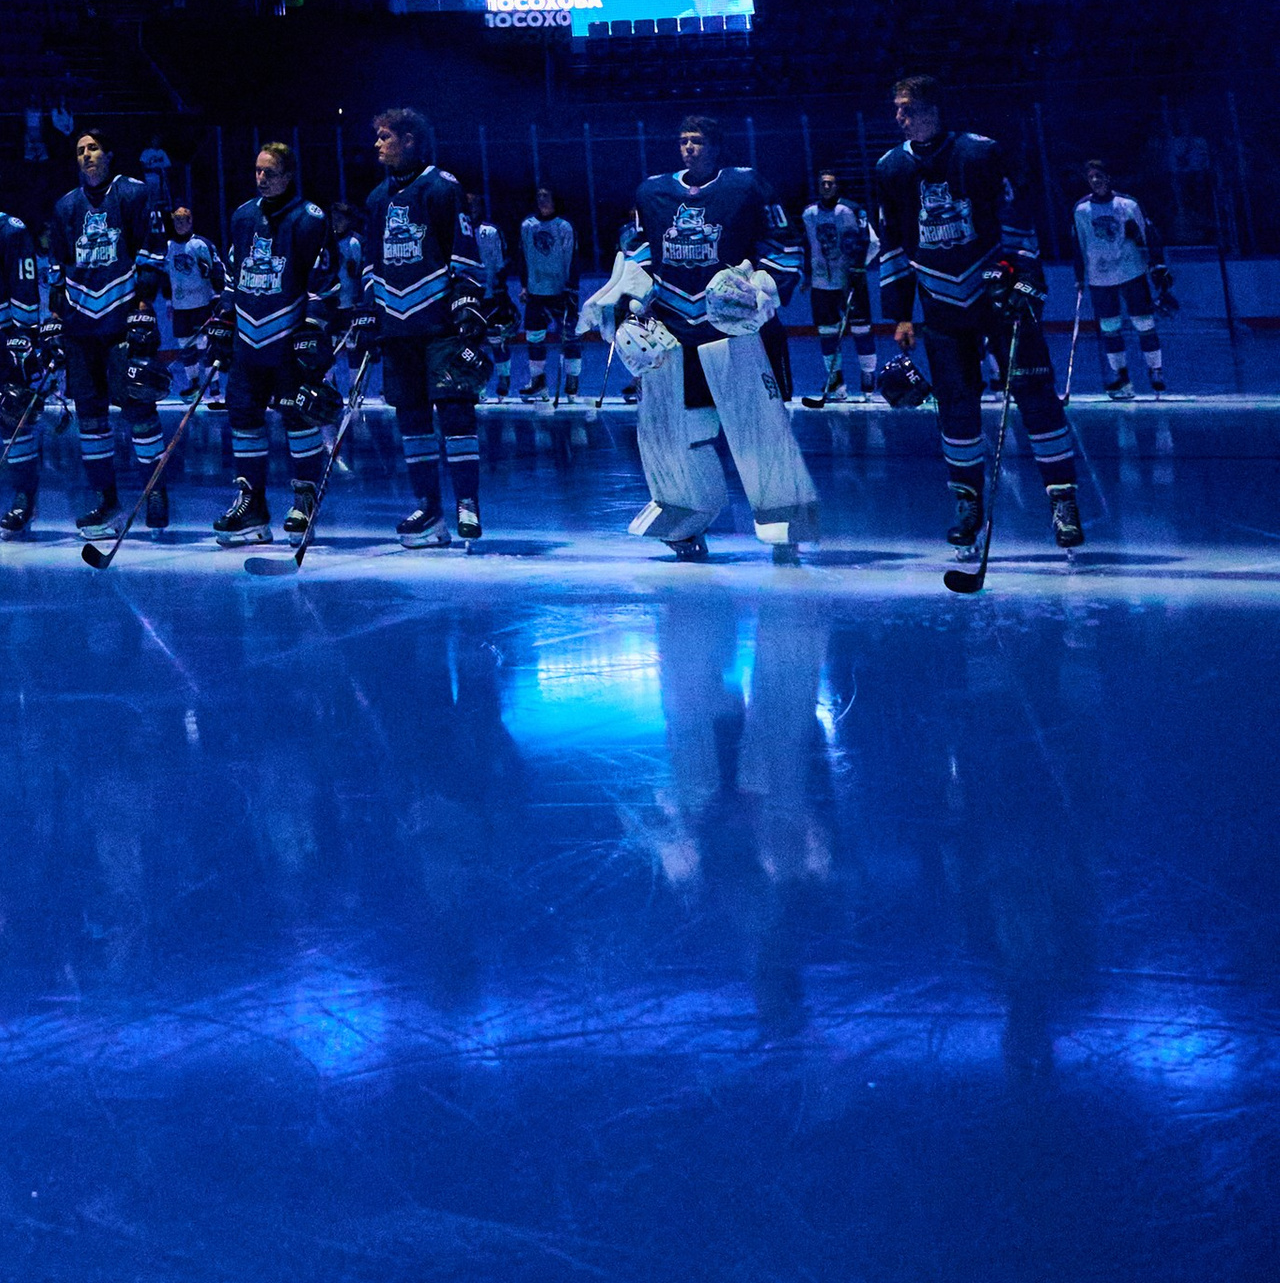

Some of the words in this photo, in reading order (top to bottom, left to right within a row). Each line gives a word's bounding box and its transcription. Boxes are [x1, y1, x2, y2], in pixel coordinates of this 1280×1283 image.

[18, 258, 36, 280] 19
[351, 317, 376, 327] UER
[40, 323, 63, 334] UER
[208, 328, 232, 337] UER
[6, 338, 27, 346] UER
[294, 340, 318, 351] UER
